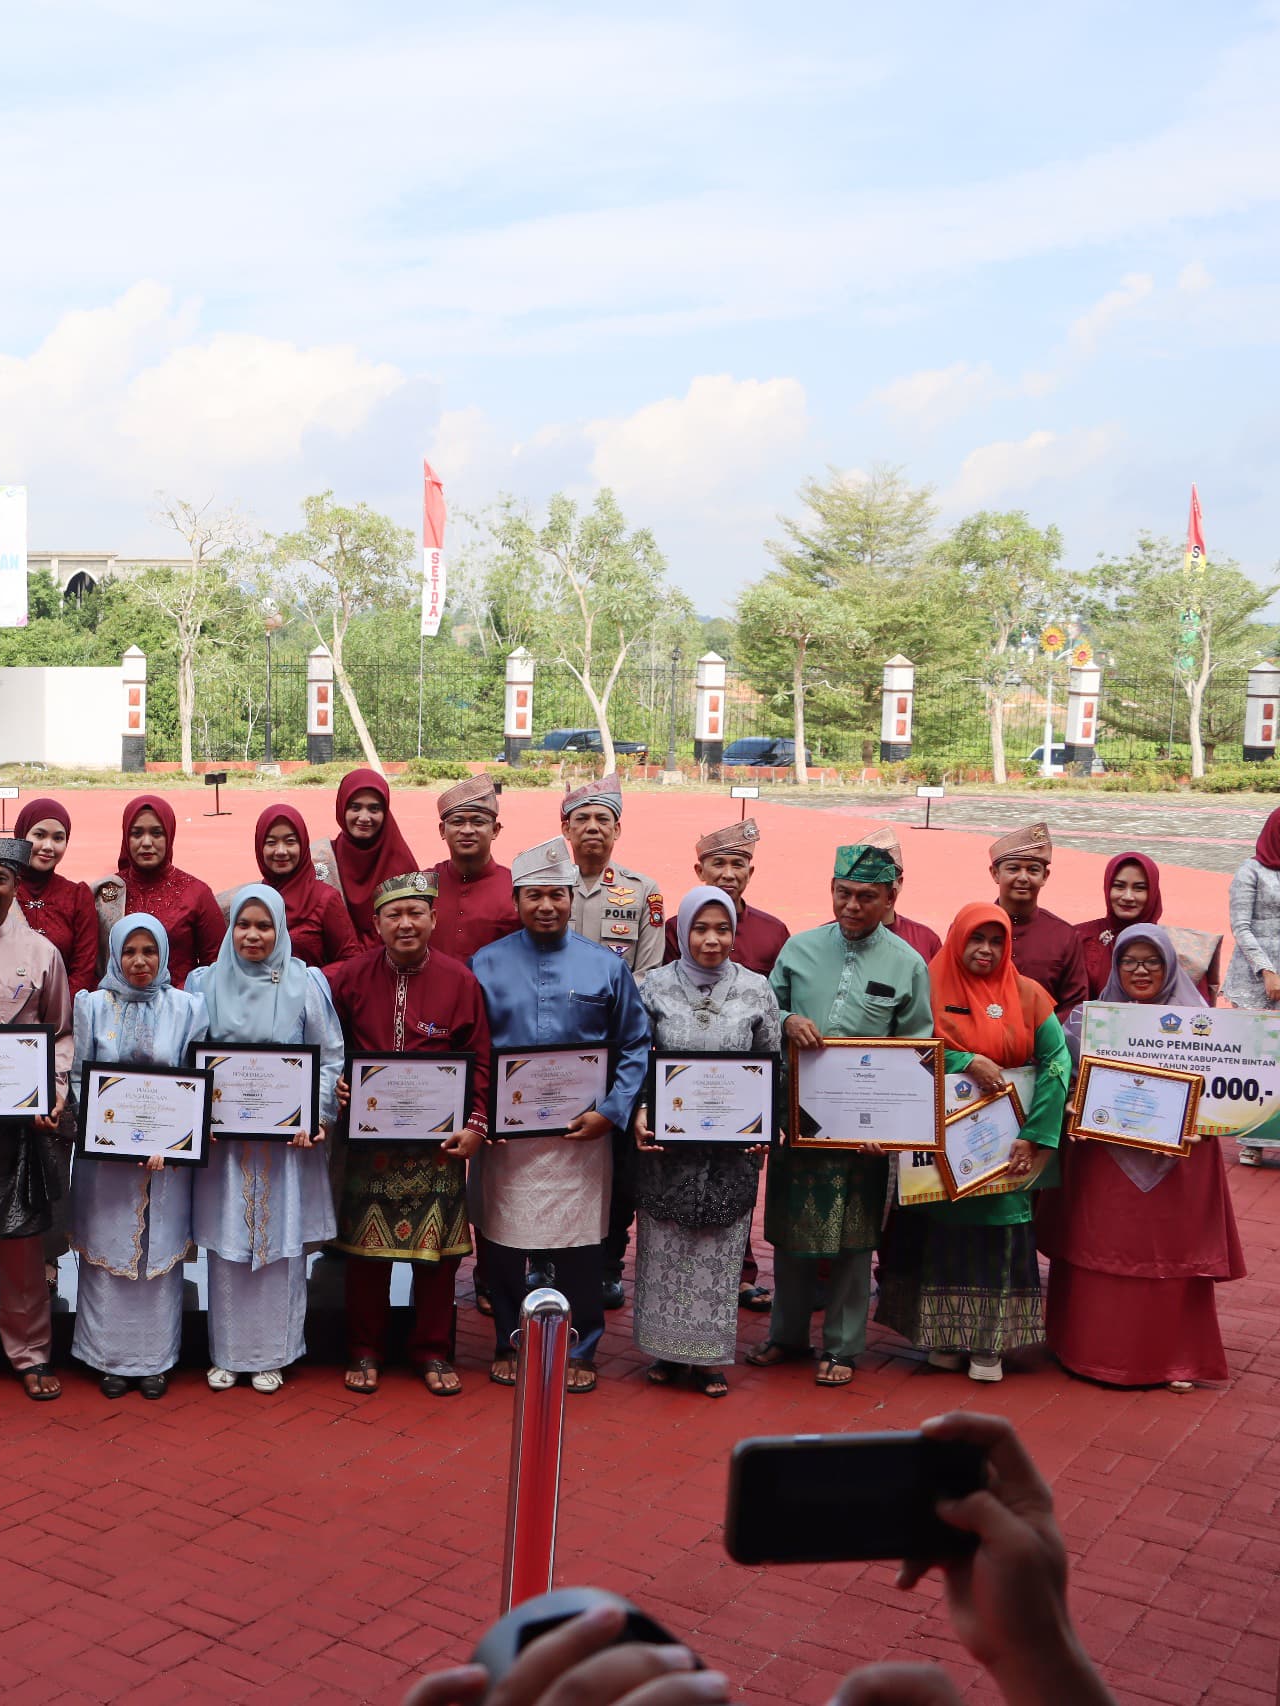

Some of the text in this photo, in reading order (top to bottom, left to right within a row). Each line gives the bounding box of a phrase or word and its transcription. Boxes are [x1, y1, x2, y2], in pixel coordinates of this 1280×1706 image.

[605, 909, 636, 919] POLRI
[1128, 1037, 1242, 1053] UANG PEMBINAAN
[1095, 1049, 1276, 1067] SEKOLAH ADIWIYATA KABUPATEN BINTAN
[1158, 1062, 1212, 1072] TAHUN 2025
